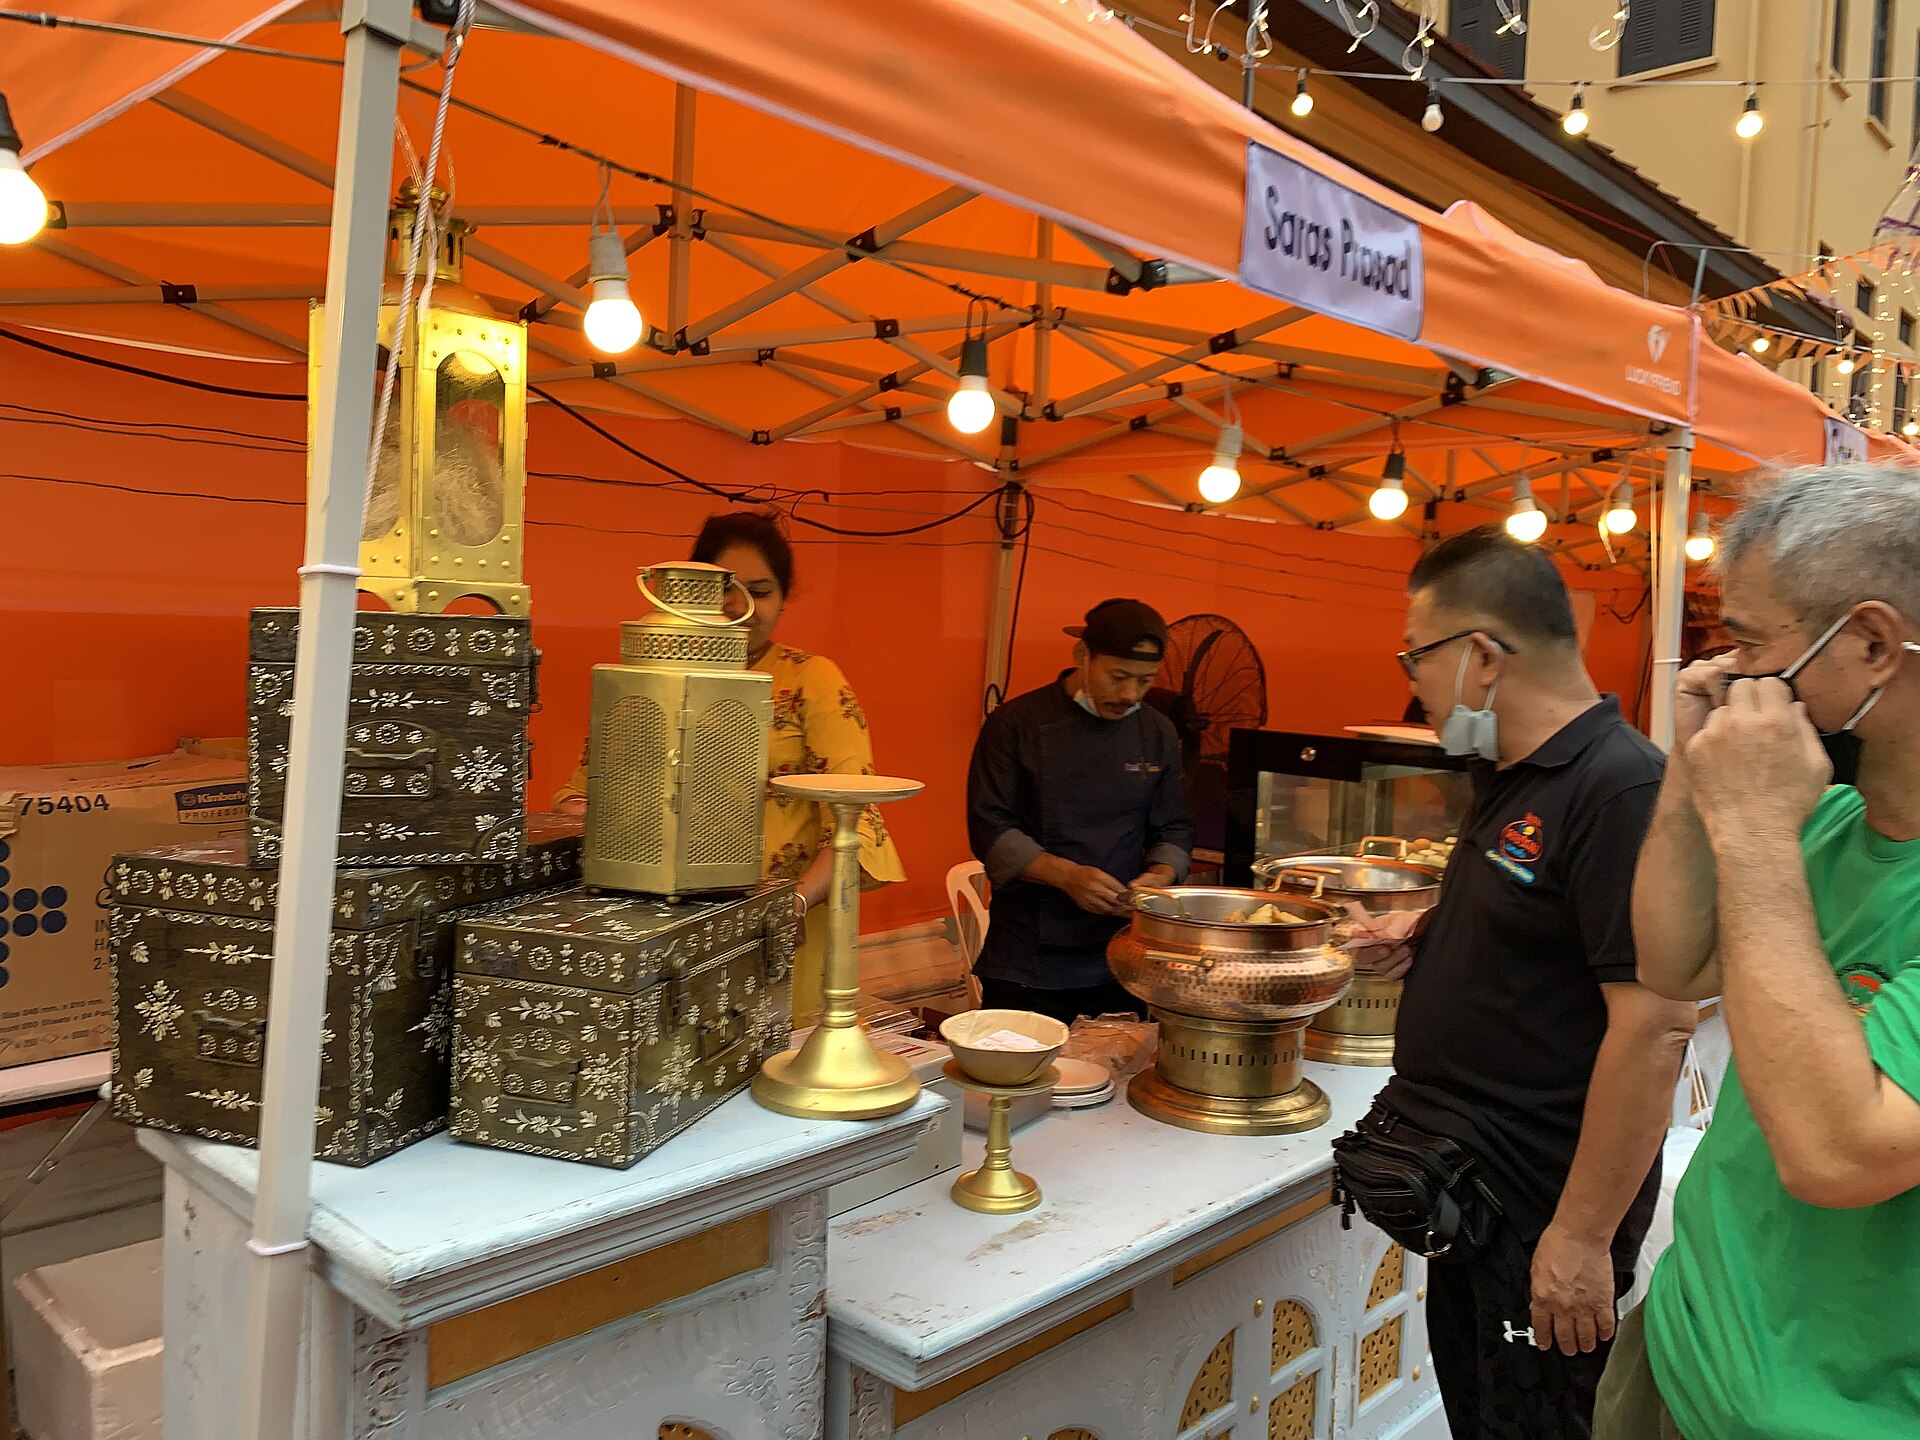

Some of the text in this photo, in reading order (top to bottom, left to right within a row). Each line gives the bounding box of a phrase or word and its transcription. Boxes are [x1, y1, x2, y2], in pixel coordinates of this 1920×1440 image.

[1264, 184, 1412, 301] Saras Prasad
[18, 793, 110, 816] 75404
